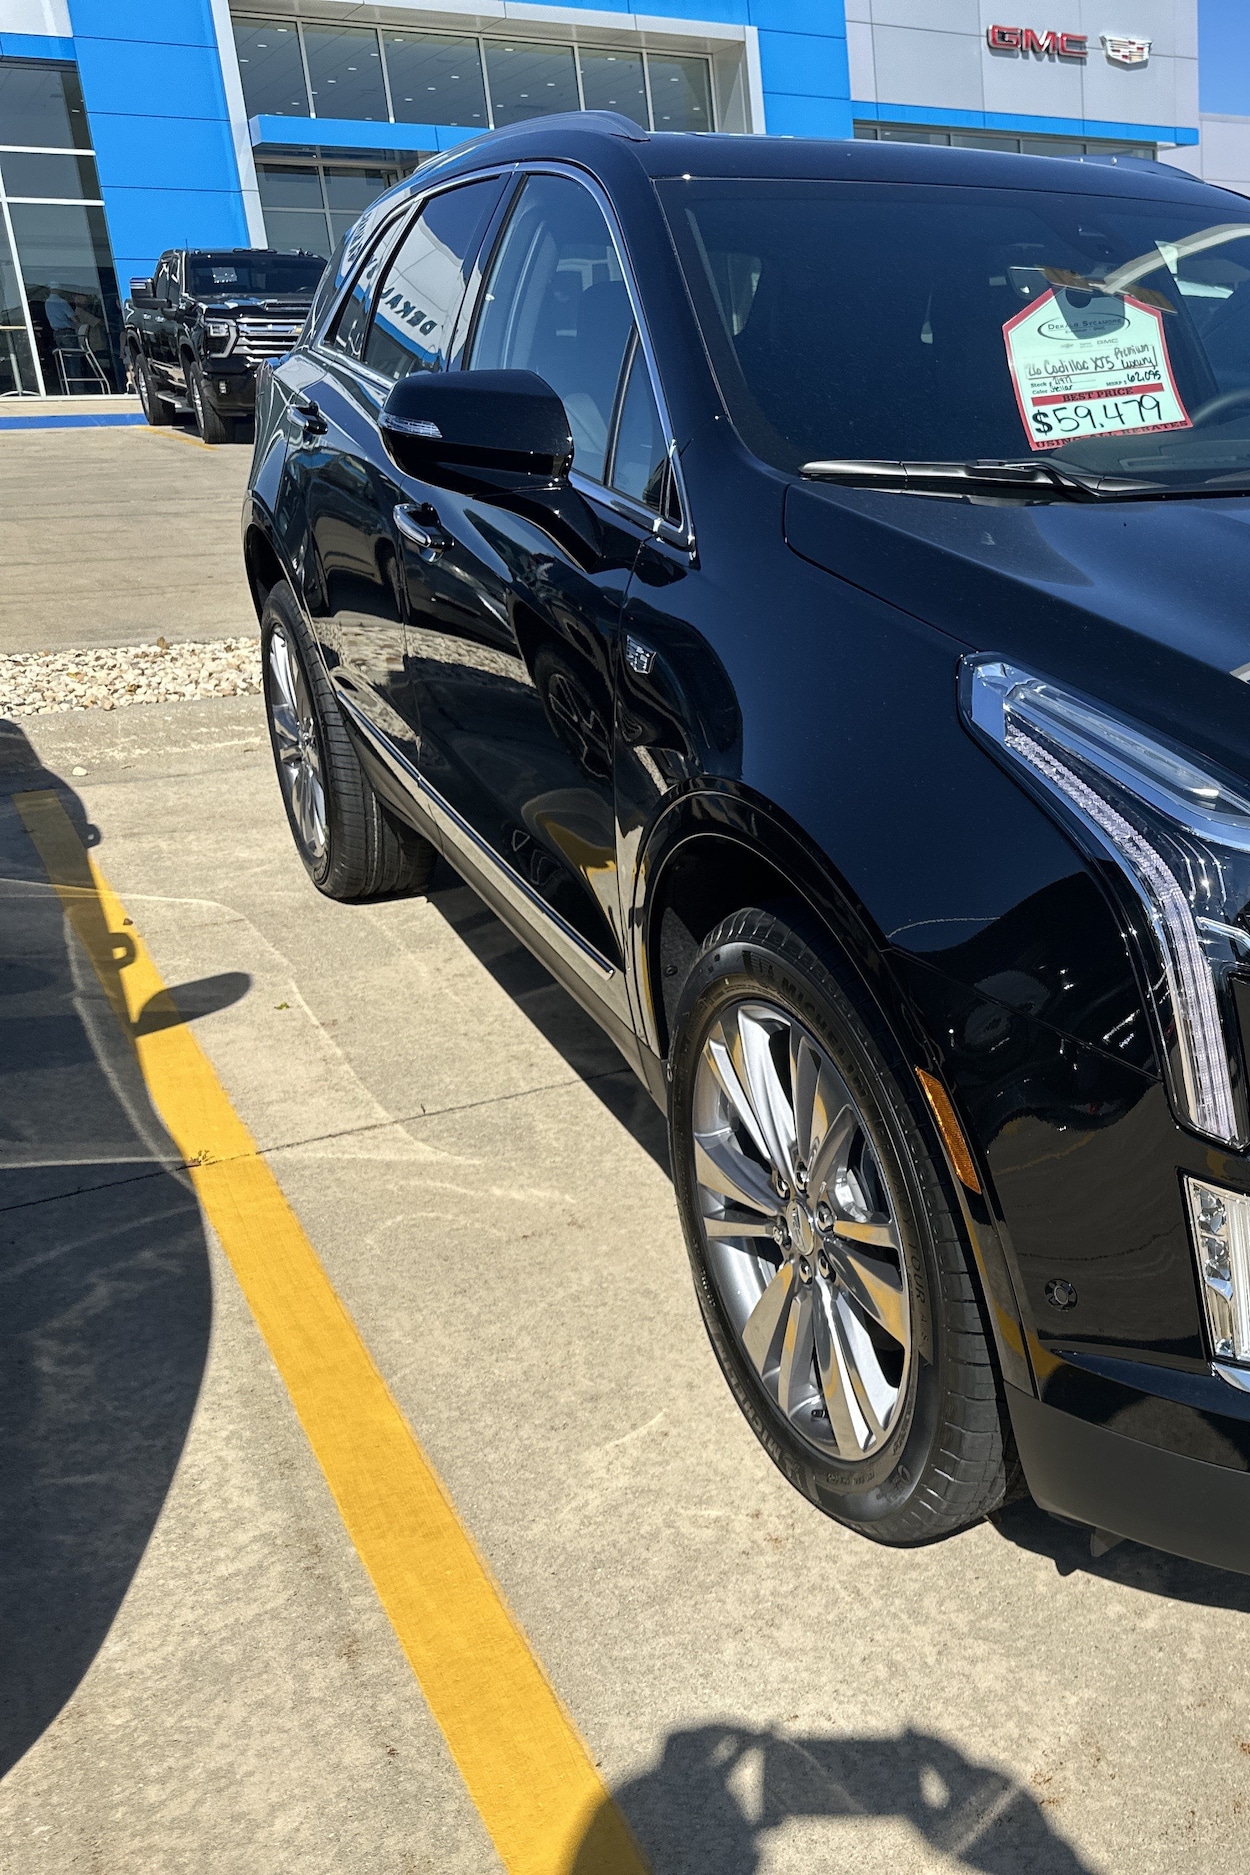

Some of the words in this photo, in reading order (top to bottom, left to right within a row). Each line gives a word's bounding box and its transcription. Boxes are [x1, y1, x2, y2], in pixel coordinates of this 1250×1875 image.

[987, 24, 1088, 57] GMC
[1044, 358, 1089, 376] Cadillac
[1090, 355, 1115, 371] XT5
[1114, 343, 1150, 361] Premium
[1062, 391, 1094, 403] BEST
[1097, 386, 1134, 399] PRICE
[781, 977, 869, 1099] MICHELIN
[907, 1241, 926, 1304] TOUR
